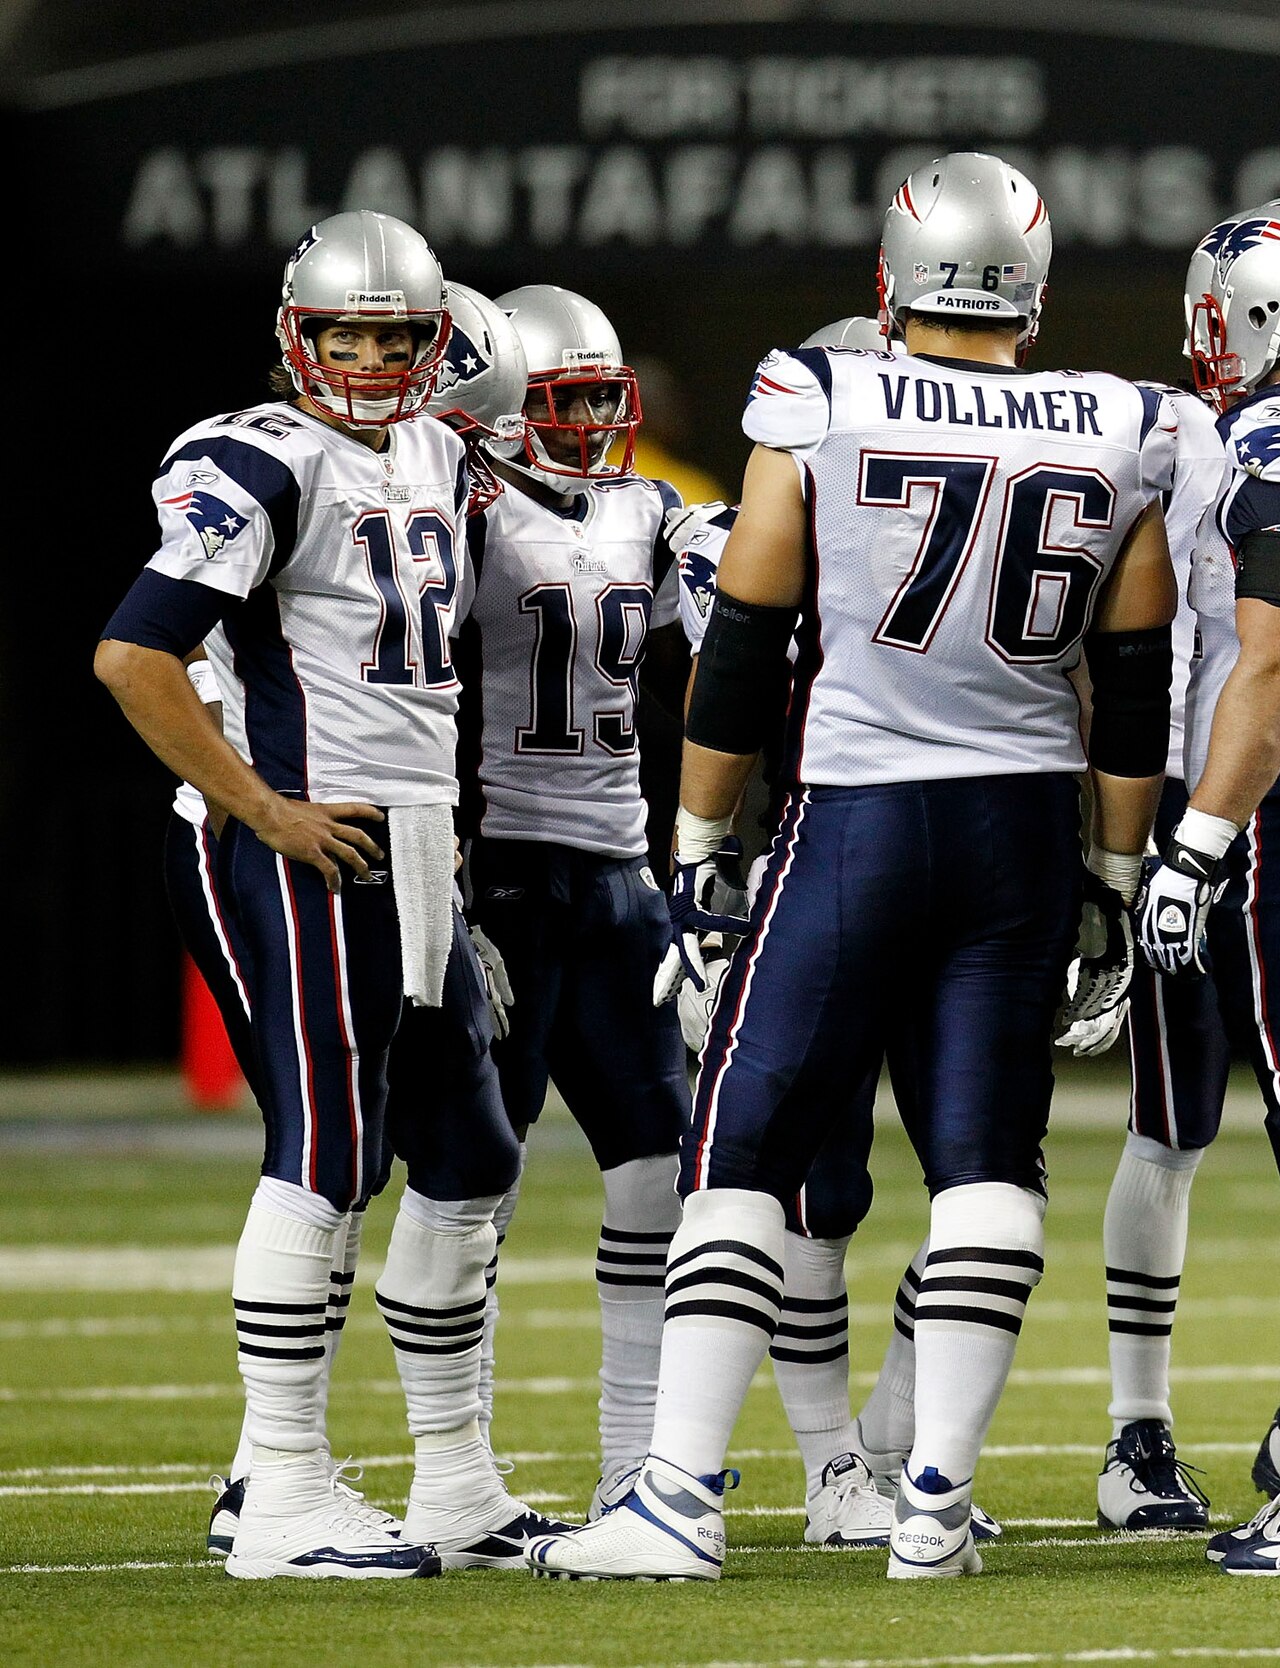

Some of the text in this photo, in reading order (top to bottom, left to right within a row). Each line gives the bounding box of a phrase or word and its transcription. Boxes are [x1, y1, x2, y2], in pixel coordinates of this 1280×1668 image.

[359, 294, 391, 303] Riddell
[937, 296, 1000, 310] PATRIOTS
[877, 373, 1103, 436] VOLLMER
[856, 449, 1118, 664] 76
[352, 509, 460, 690] 12
[514, 582, 655, 757] 19
[898, 1533, 945, 1548] Reebok
